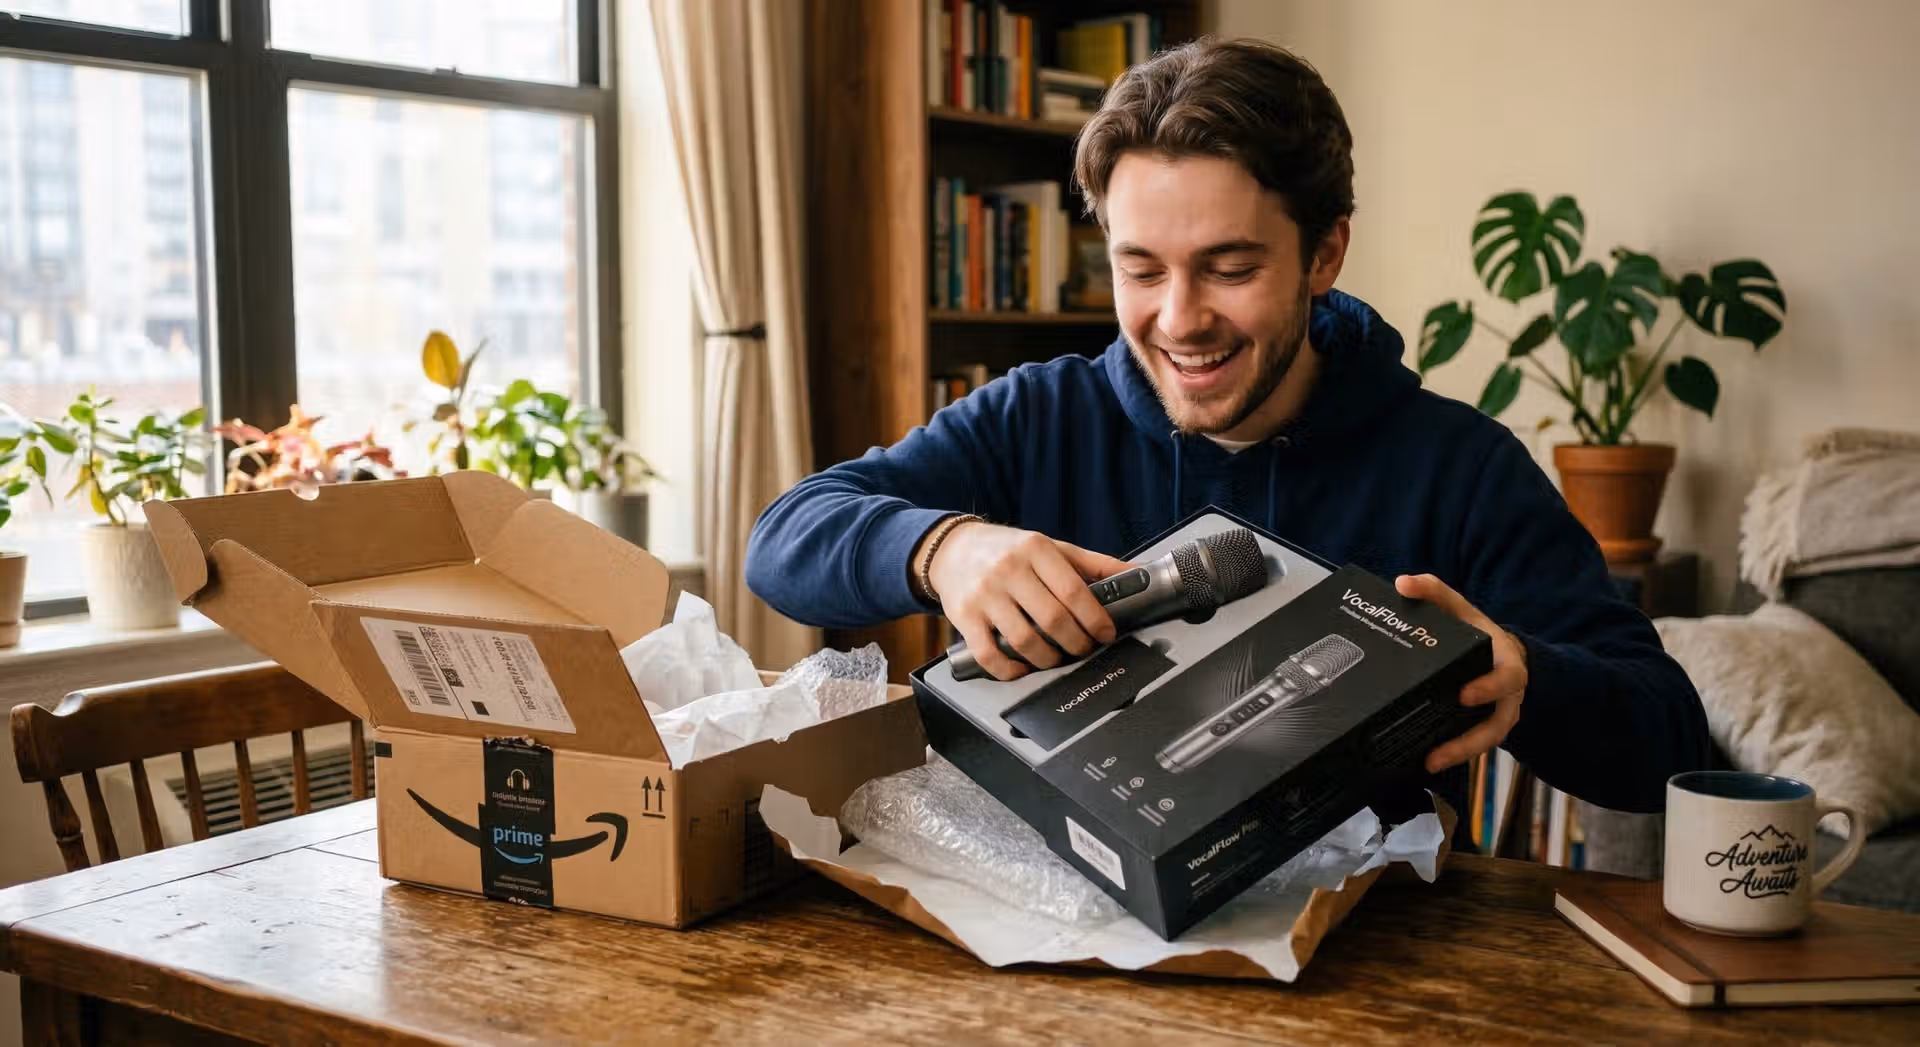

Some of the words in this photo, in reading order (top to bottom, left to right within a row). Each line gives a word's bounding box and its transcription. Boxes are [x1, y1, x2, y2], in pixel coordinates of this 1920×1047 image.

[1342, 588, 1413, 632] VocalFlow
[1409, 627, 1438, 647] Pro
[1056, 679, 1108, 713] VocalFlow
[1105, 667, 1126, 681] Pro
[493, 825, 544, 847] prime
[1186, 831, 1240, 870] VocalFlow
